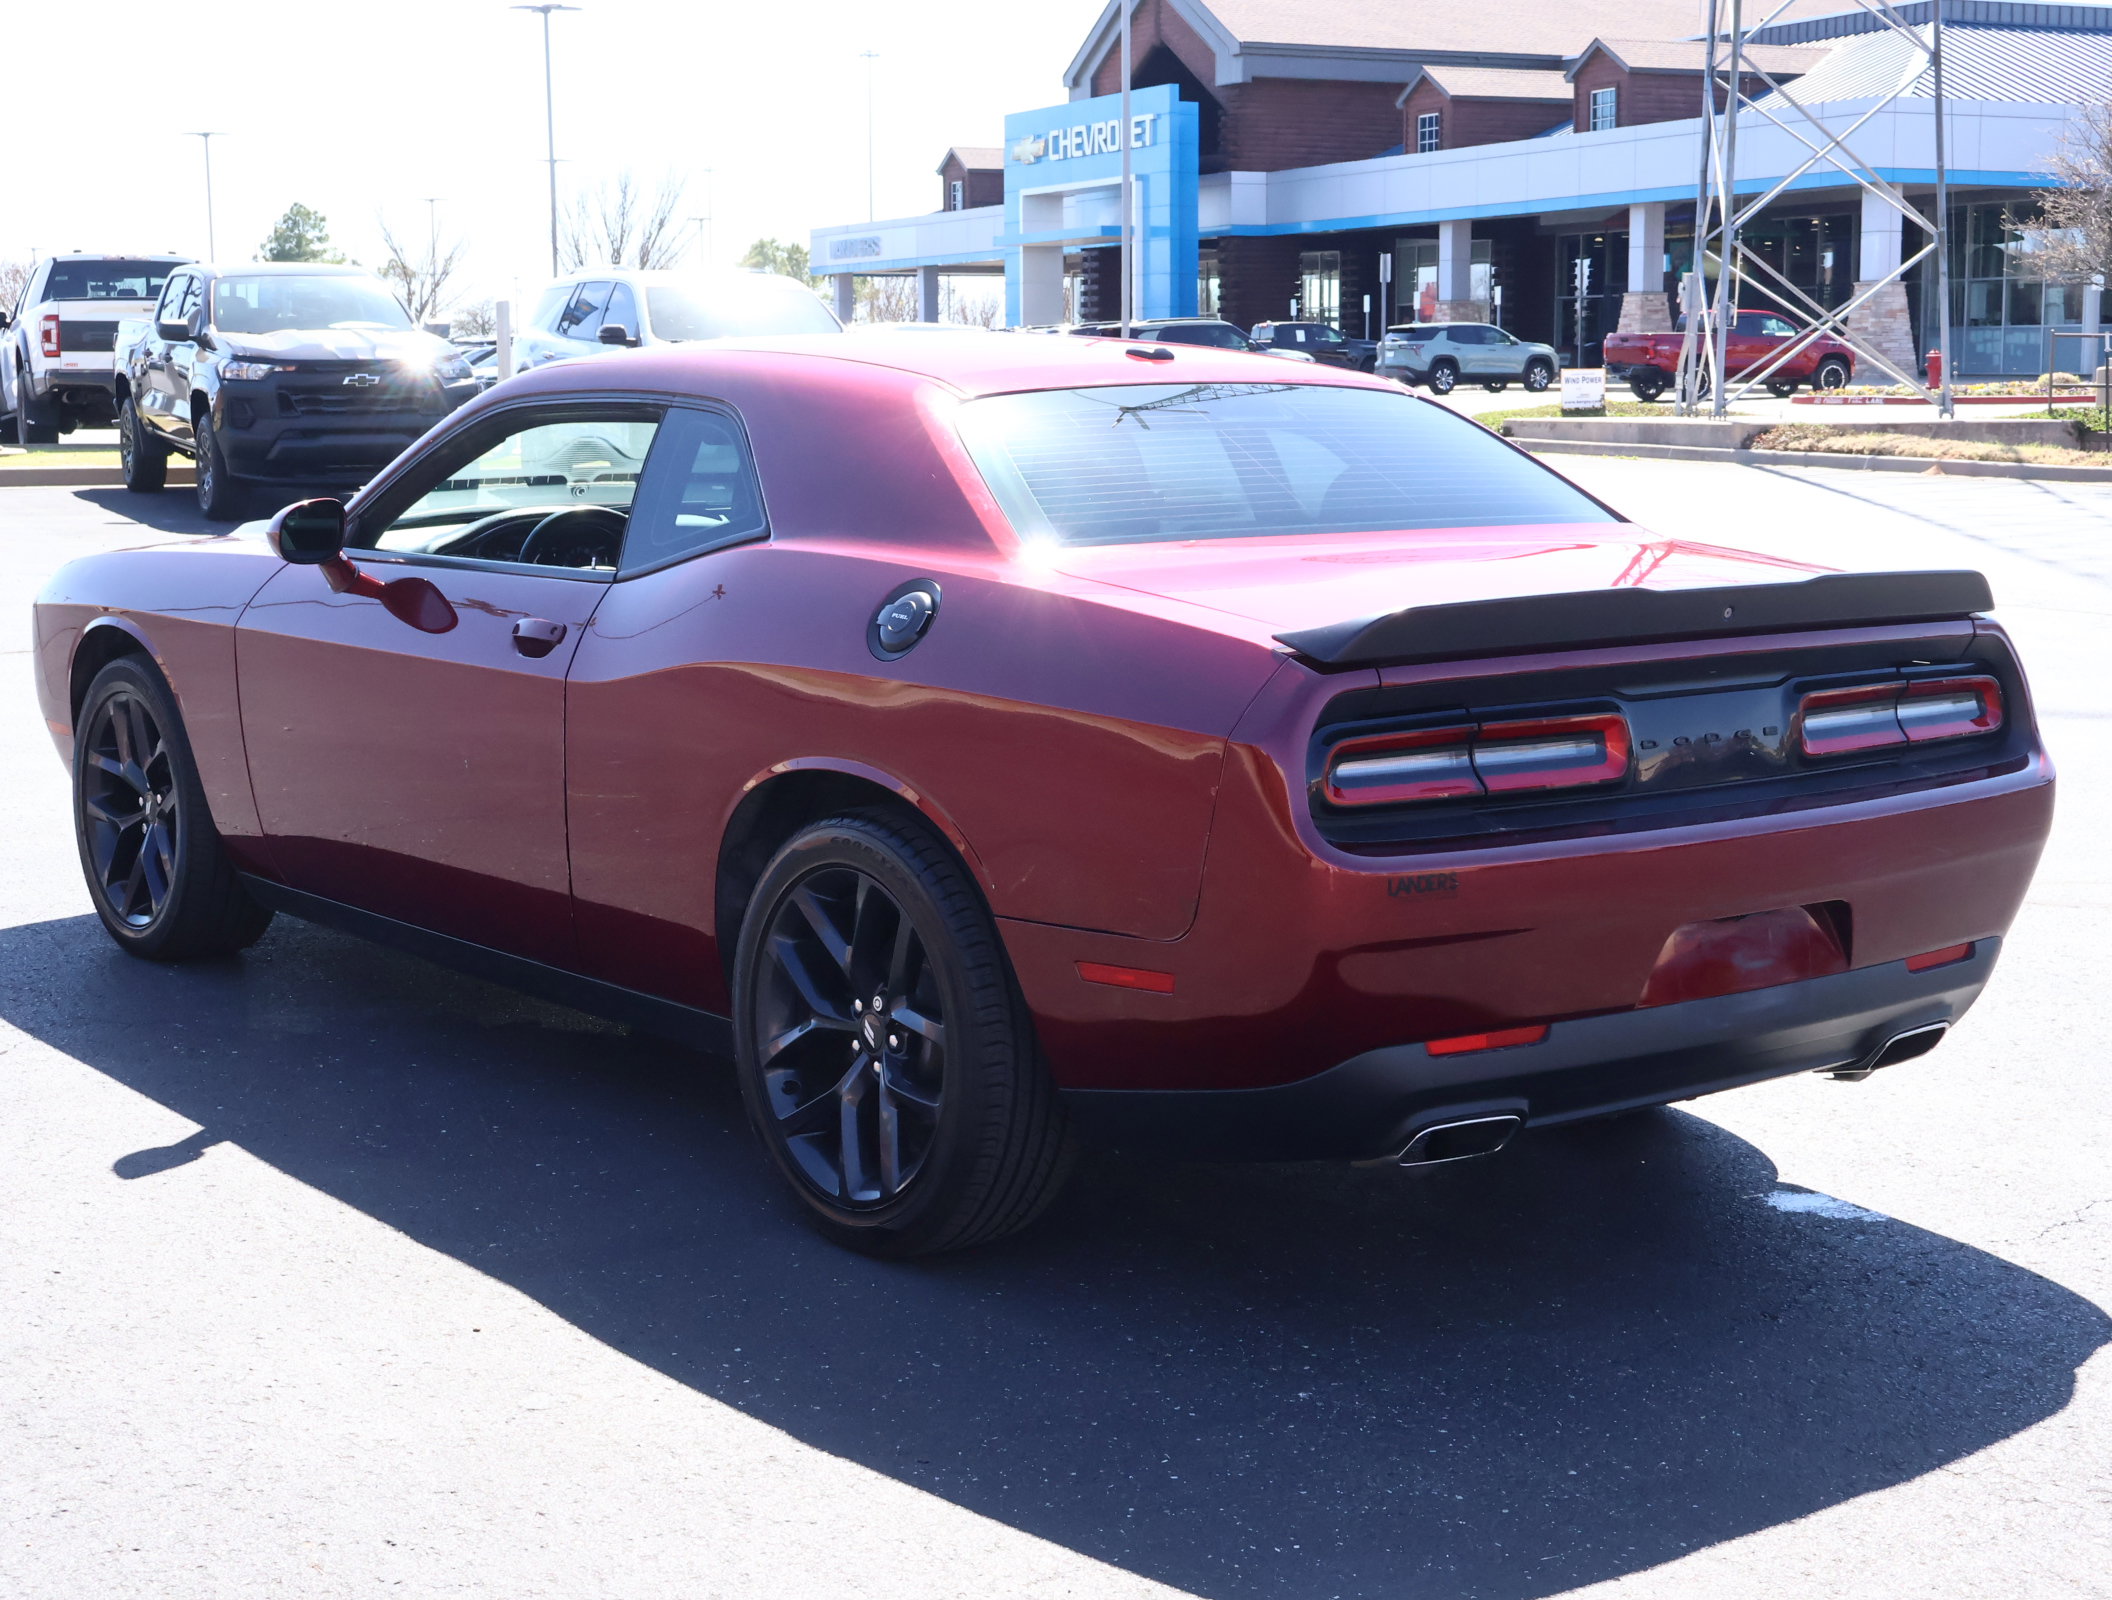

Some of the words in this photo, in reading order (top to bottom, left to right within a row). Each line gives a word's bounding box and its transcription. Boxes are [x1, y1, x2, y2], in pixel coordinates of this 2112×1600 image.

[1581, 376, 1602, 384] POWER
[891, 612, 908, 620] FUEL
[1640, 726, 1778, 750] DODGE
[1387, 873, 1457, 897] LANDERS
